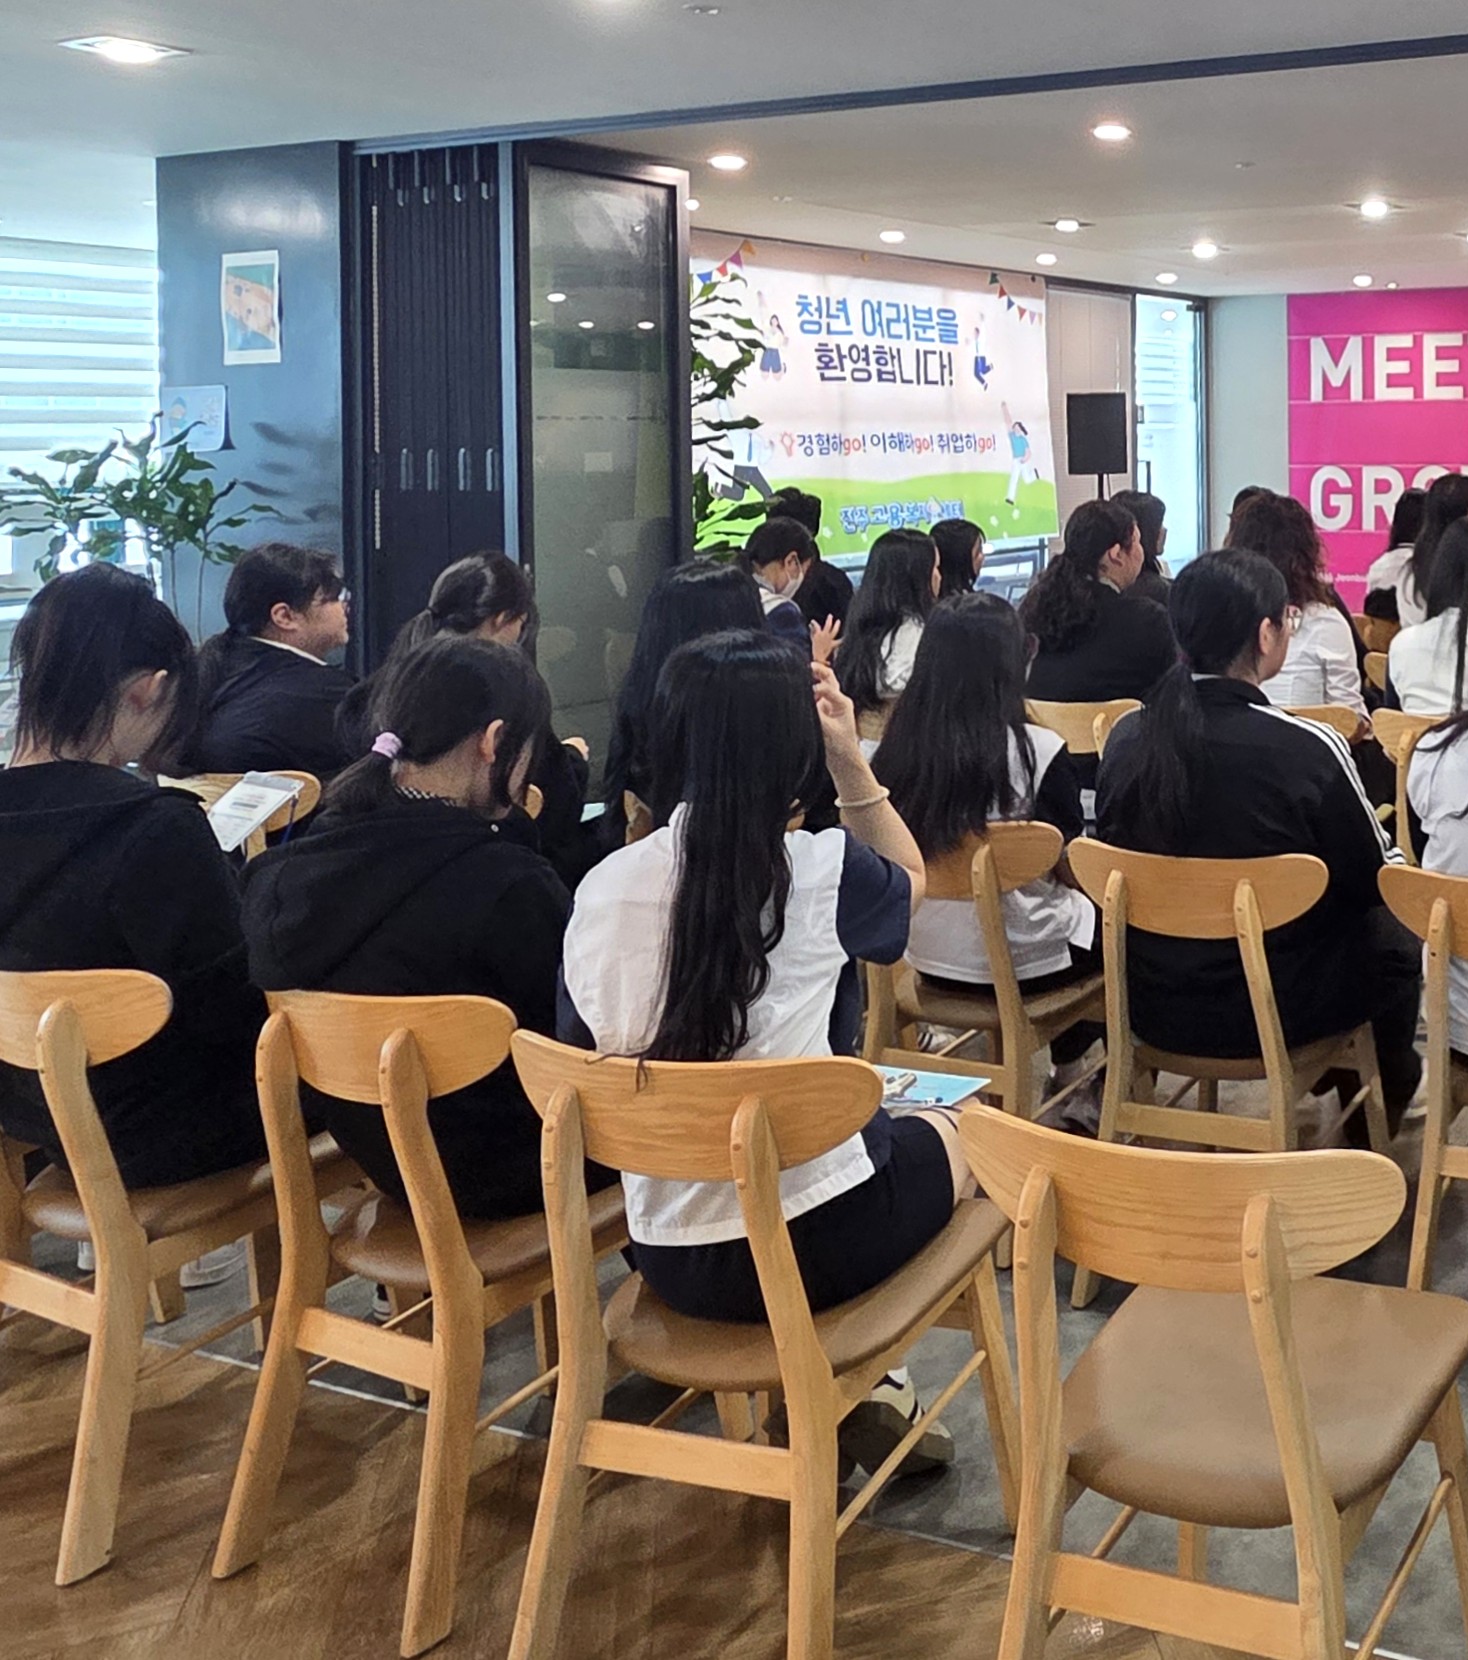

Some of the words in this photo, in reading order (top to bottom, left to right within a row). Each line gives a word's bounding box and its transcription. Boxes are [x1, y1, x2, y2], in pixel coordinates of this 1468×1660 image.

[795, 293, 854, 336] 청년
[861, 298, 959, 345] 여러분을
[813, 342, 954, 387] 환영합니다!
[796, 431, 867, 458] 경험하go!
[937, 431, 997, 454] 취업하go!
